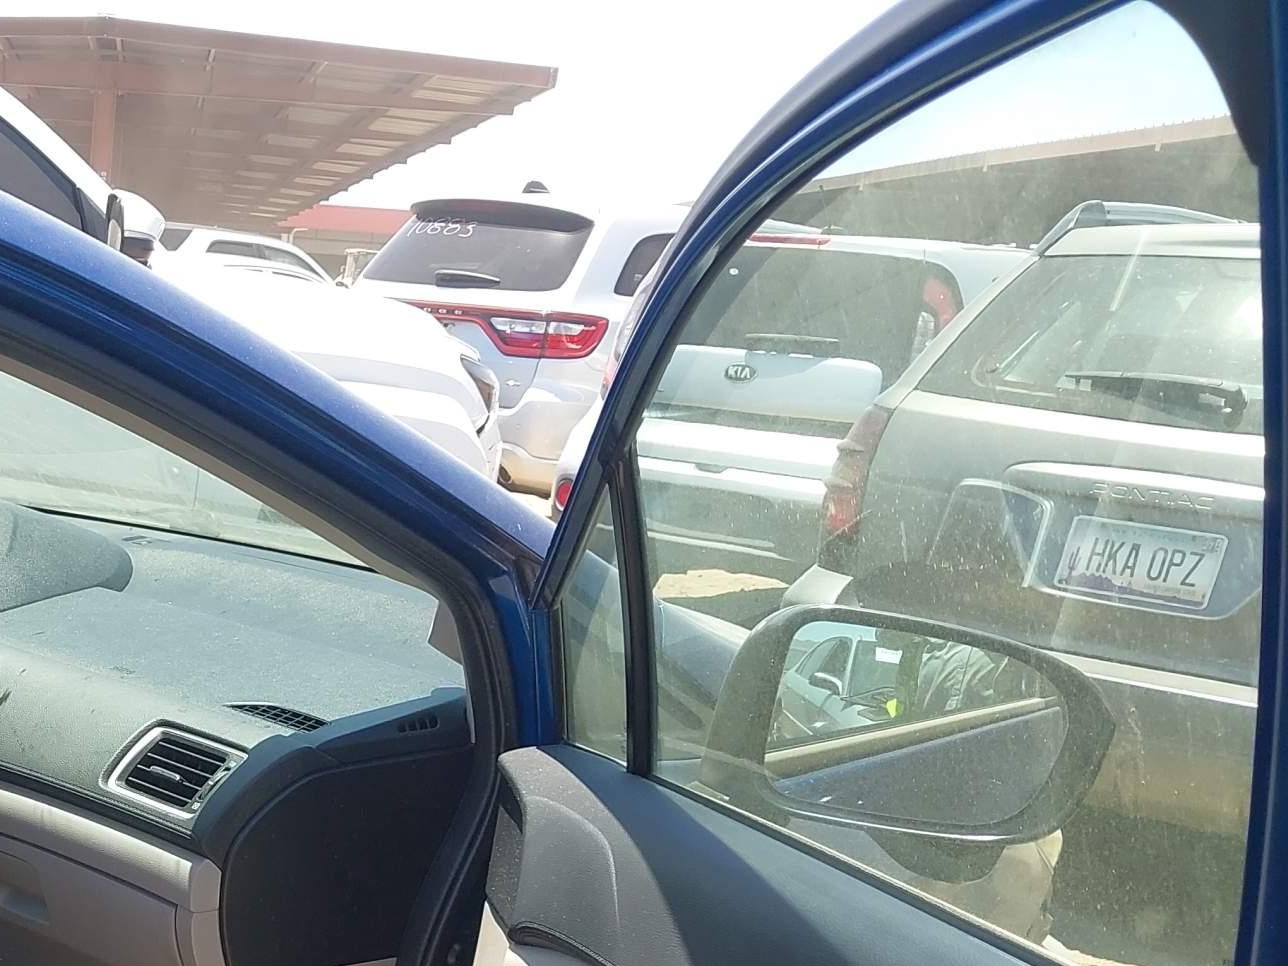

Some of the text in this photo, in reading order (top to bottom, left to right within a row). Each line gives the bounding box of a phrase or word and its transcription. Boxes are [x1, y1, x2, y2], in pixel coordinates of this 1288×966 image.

[727, 366, 751, 379] KIA
[1089, 482, 1215, 511] PONTIAC
[1086, 537, 1141, 577] HKA
